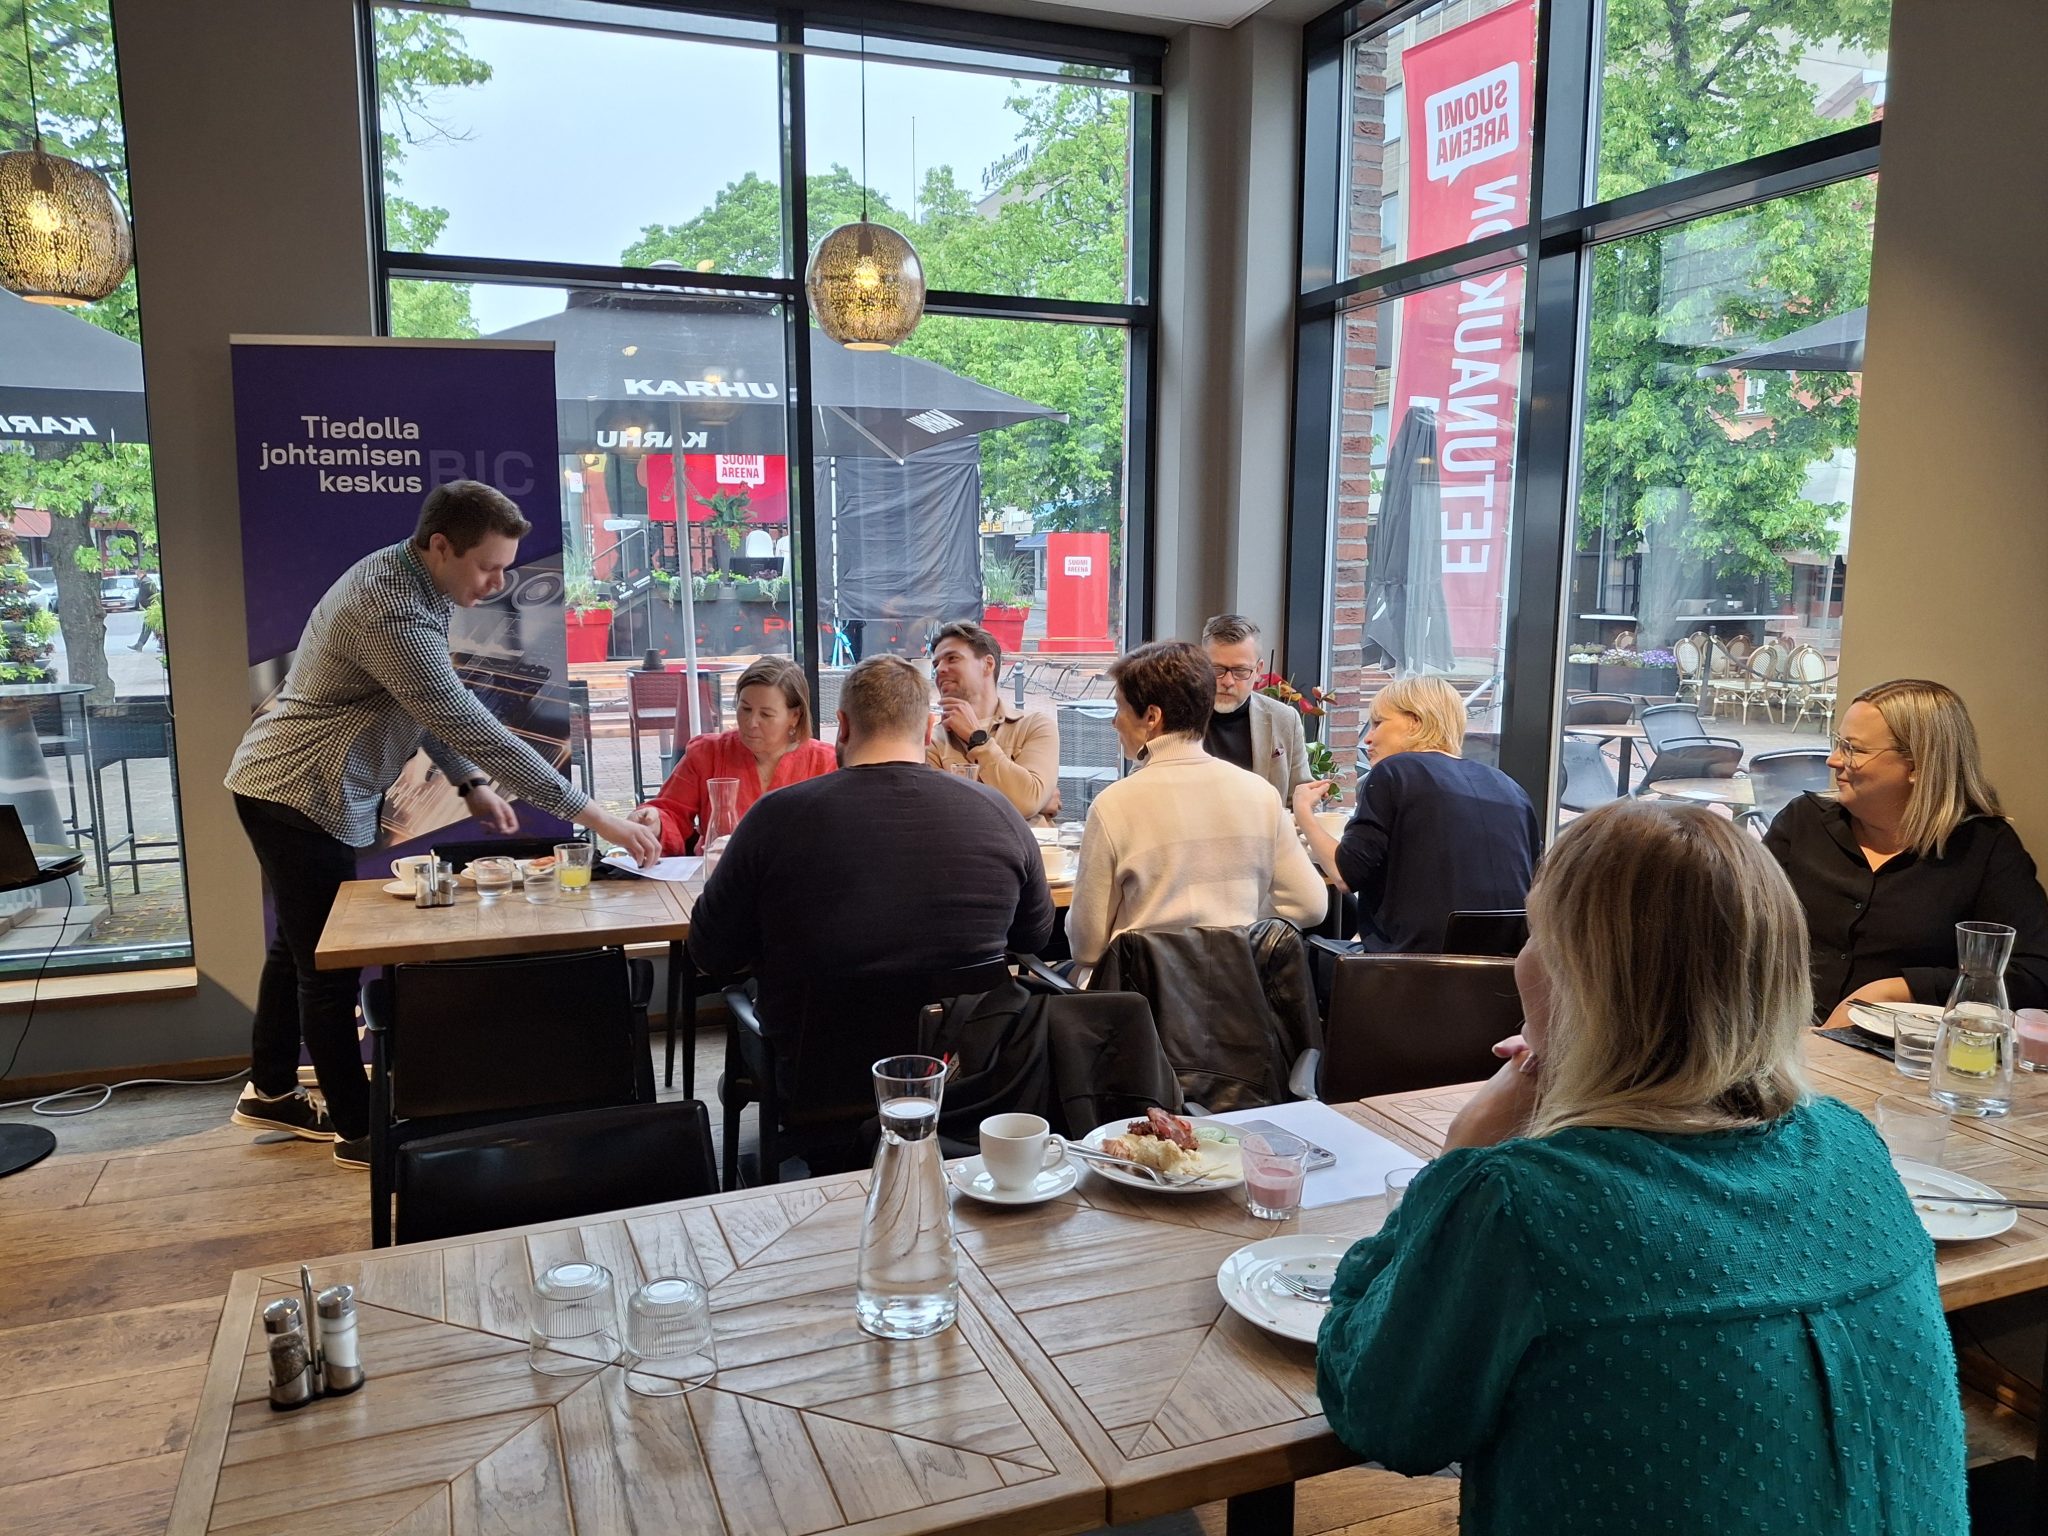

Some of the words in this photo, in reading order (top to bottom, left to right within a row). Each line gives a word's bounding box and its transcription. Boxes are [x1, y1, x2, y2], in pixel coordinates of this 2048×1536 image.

[623, 378, 779, 399] KARHU
[301, 416, 420, 440] Tiedolla
[259, 442, 421, 471] johtamisen
[722, 454, 758, 465] SUOMI
[319, 470, 423, 493] keskus
[429, 449, 535, 497] BIC
[721, 467, 760, 479] AREENA
